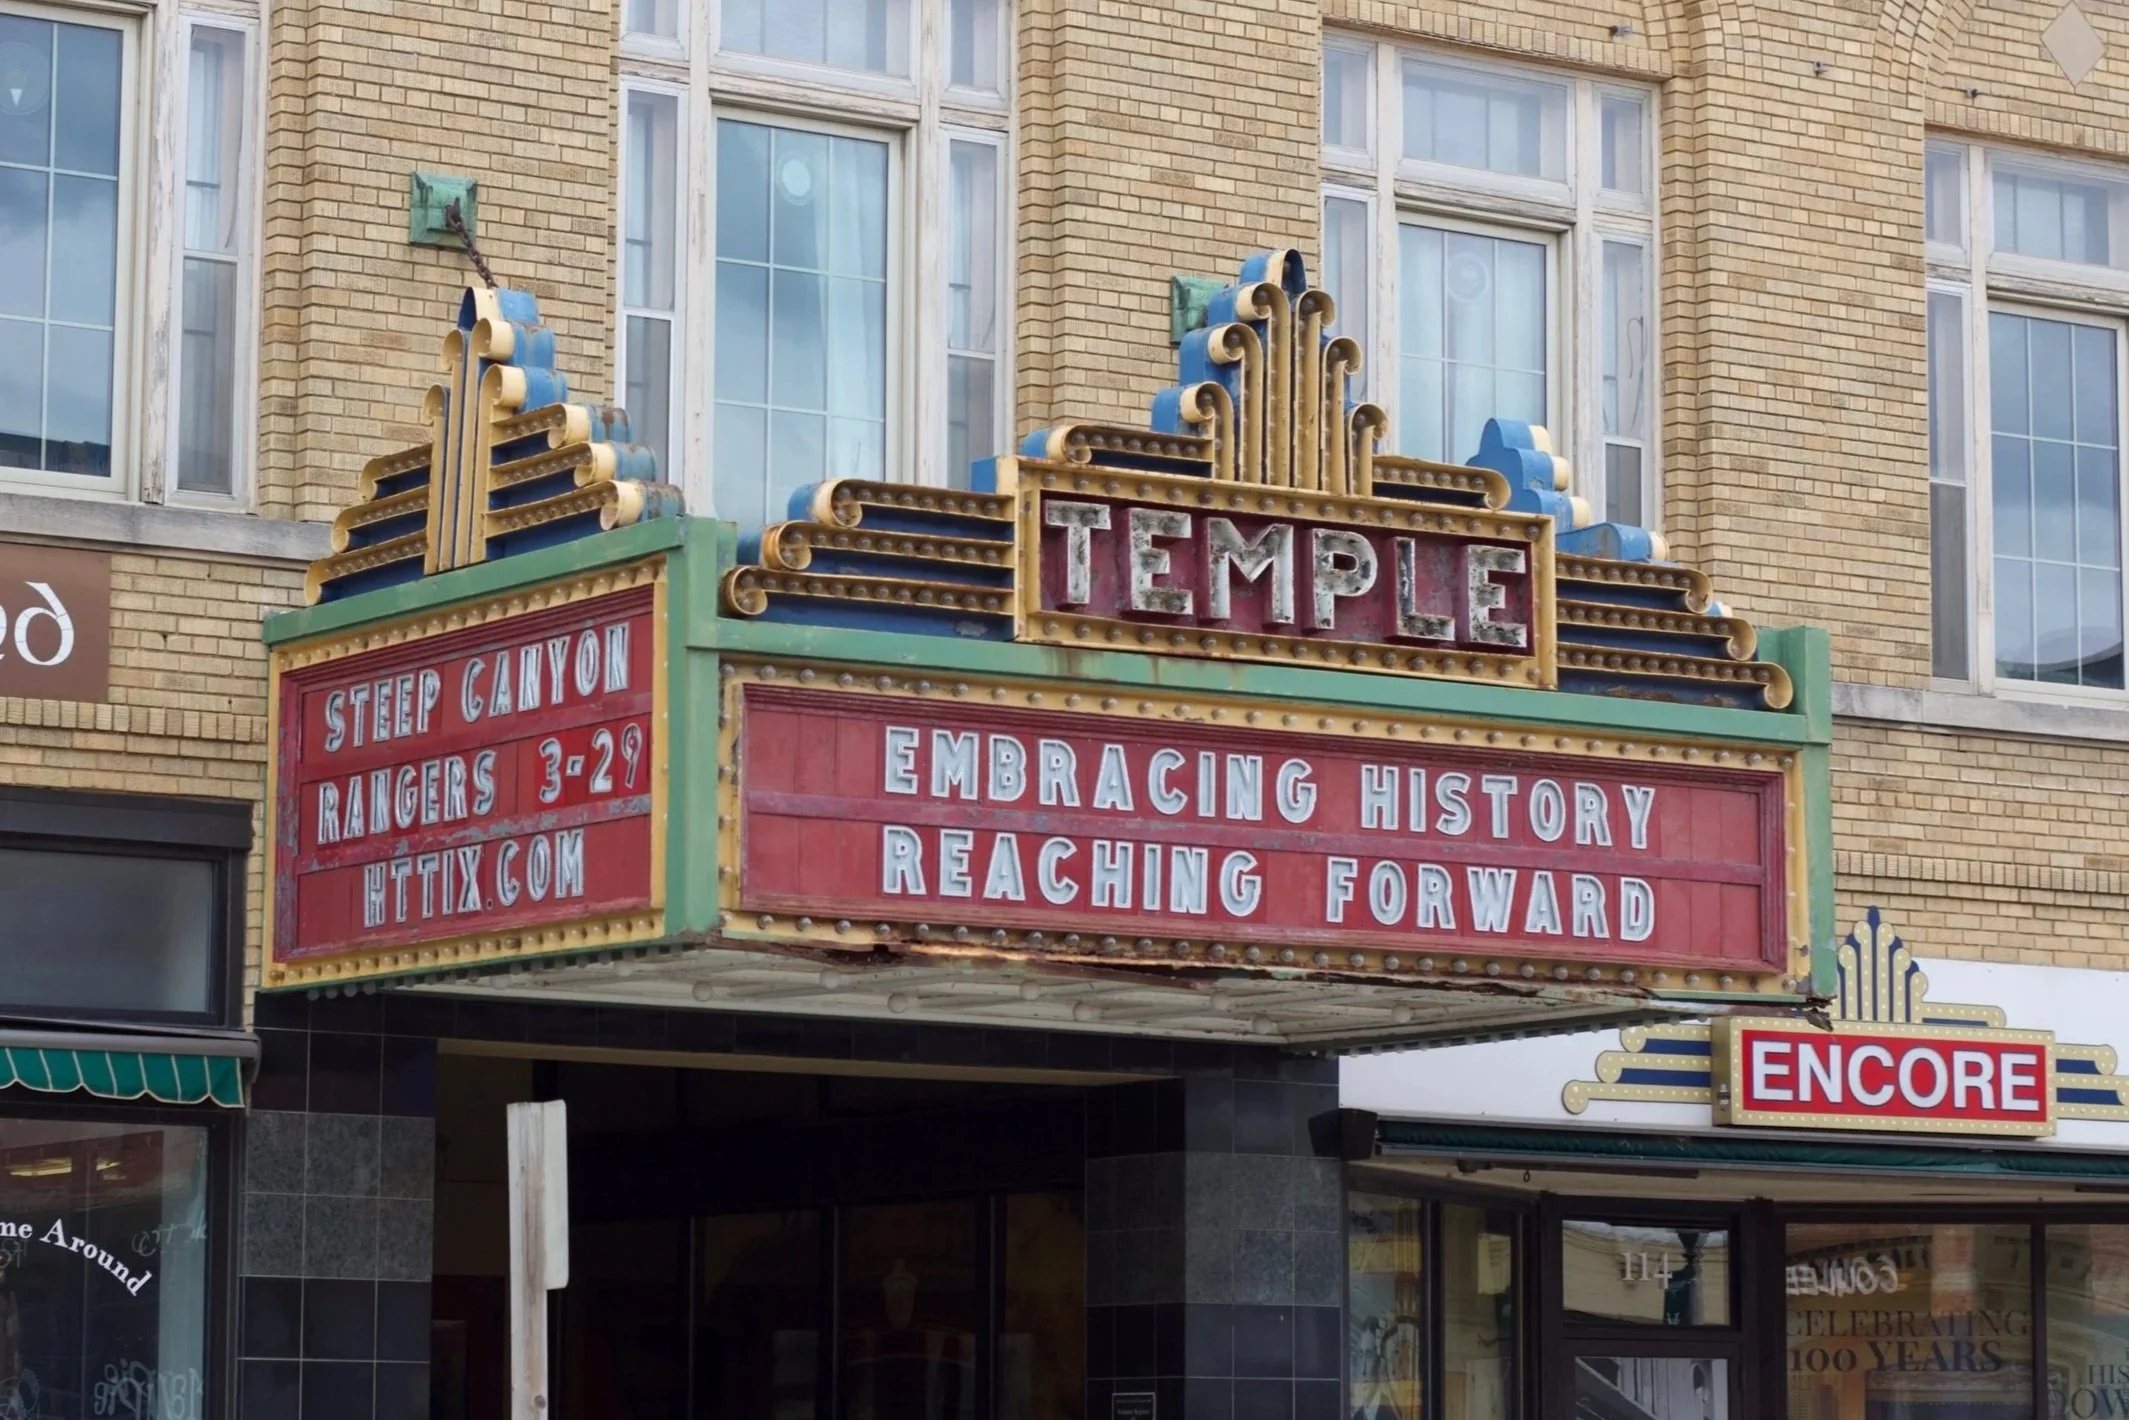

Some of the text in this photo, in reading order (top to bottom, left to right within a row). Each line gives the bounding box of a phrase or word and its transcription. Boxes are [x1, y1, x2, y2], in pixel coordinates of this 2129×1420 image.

[1042, 498, 1528, 650] TEMPLE
[324, 620, 630, 753] STEEP CANYON
[317, 722, 643, 845] RANGERS 3-29
[884, 725, 1656, 850] EMBRACING HISTORY
[362, 828, 585, 929] HTTIX.COM
[883, 824, 1655, 942] REACHING FORWARD
[1751, 1040, 2040, 1112] ENCORE
[39, 1217, 153, 1297] Around
[1621, 1250, 1673, 1290] 114
[1786, 1309, 2029, 1337] CELEBRATING
[1787, 1340, 2003, 1373] 100 YEARS
